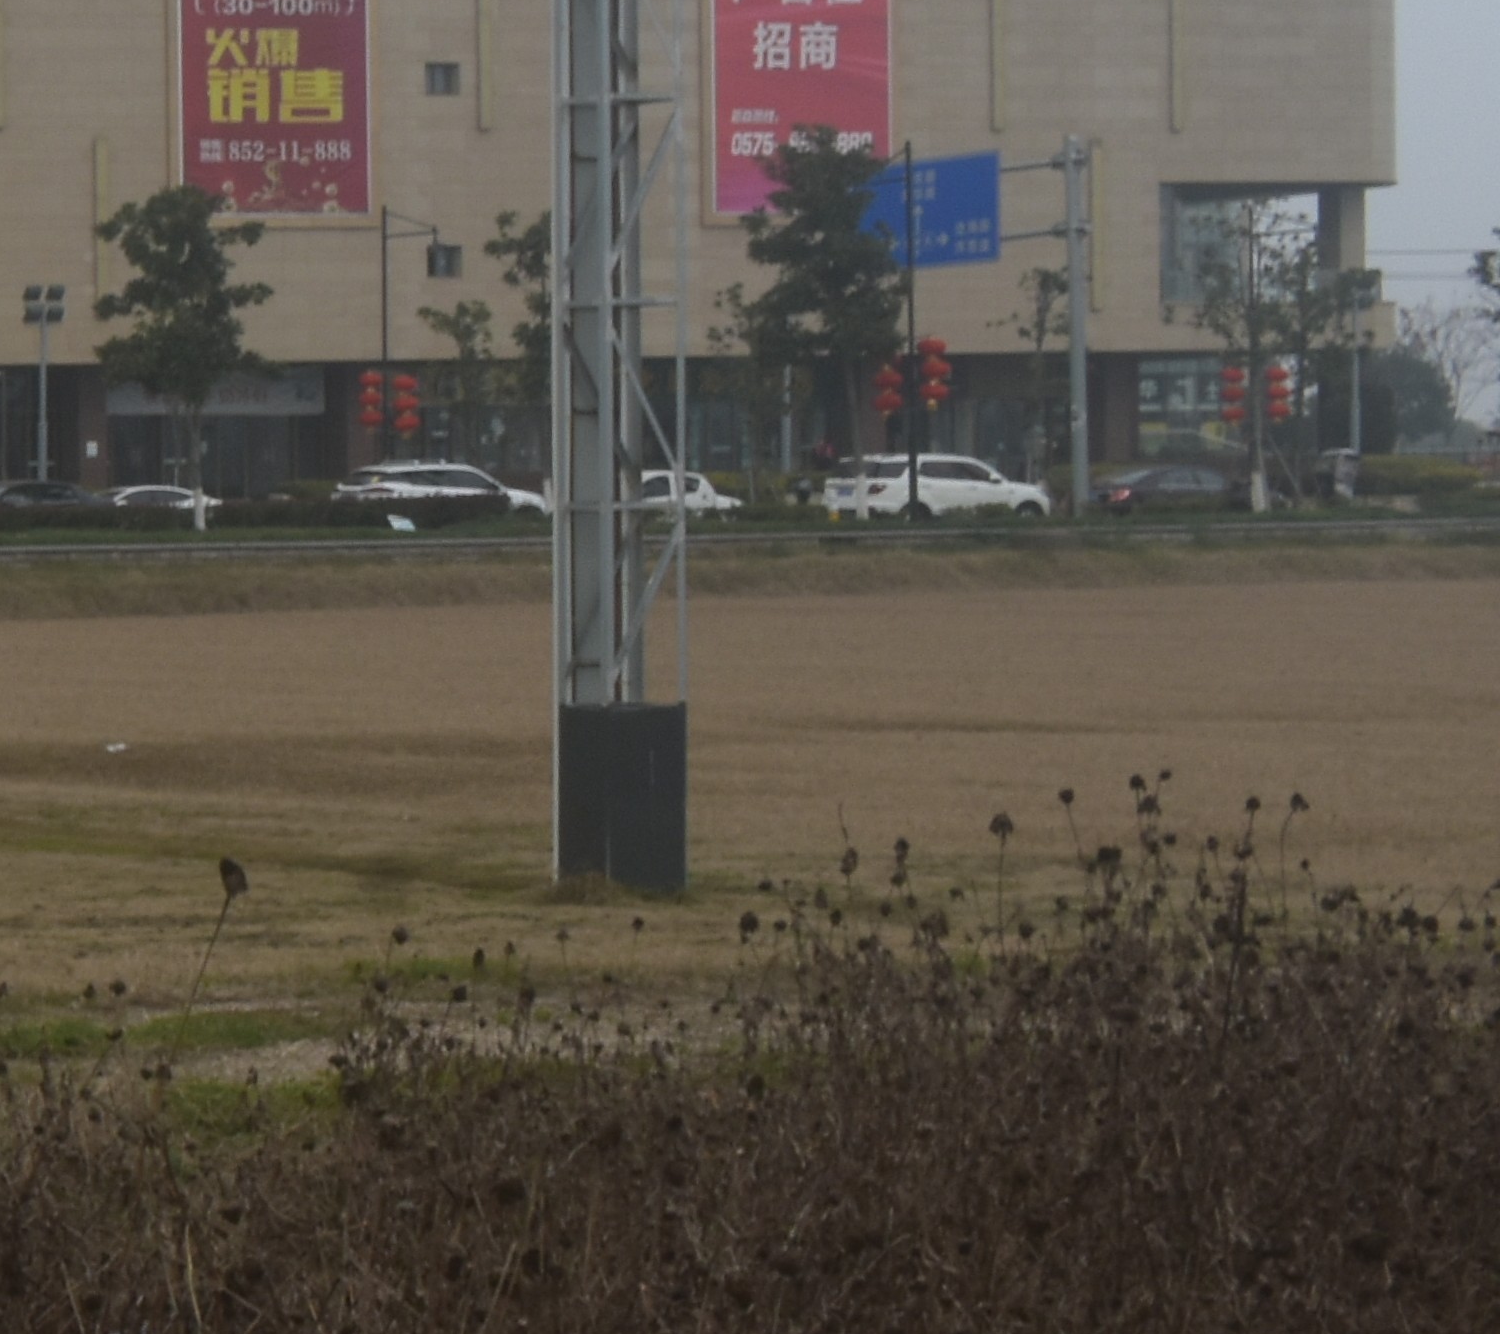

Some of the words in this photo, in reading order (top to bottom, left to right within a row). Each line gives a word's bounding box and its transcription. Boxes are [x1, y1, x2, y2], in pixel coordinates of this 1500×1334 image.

[205, 27, 299, 67] 火爆
[752, 21, 839, 71] 招商
[206, 69, 344, 123] 销售
[228, 138, 353, 163] 852-11-888
